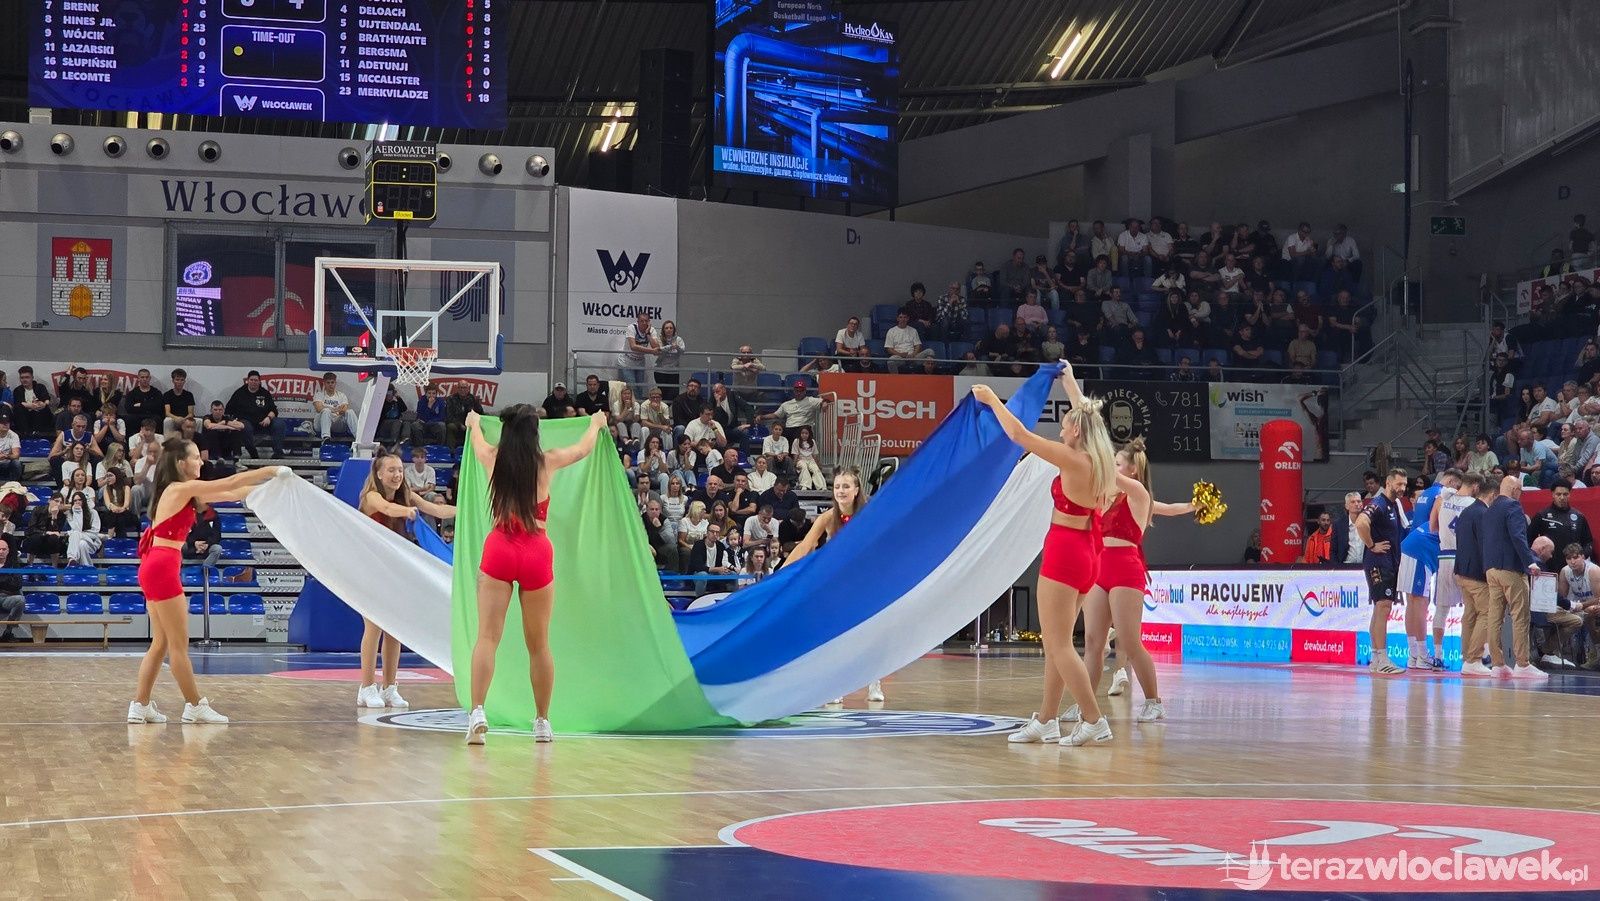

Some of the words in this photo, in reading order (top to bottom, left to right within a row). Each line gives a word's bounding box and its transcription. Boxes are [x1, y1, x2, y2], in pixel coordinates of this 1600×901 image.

[45, 1, 52, 9] 7
[63, 2, 99, 12] BRENK
[182, 9, 188, 17] 1
[199, 10, 206, 18] 6
[340, 5, 347, 13] 4
[358, 6, 406, 17] DELOACH
[484, 14, 490, 22] 8
[777, 1, 805, 10] European
[45, 15, 52, 23] 8
[63, 16, 95, 26] HINES
[99, 18, 116, 27] JR.
[193, 23, 206, 32] 23
[773, 11, 805, 21] Basketball
[340, 19, 347, 27] 5
[358, 20, 422, 31] UIJTENDAAL
[484, 27, 490, 35] 8
[44, 29, 52, 37] 9
[62, 28, 105, 40] WÓJCIK
[181, 36, 188, 45] 0
[199, 38, 206, 46] 0
[252, 31, 296, 44] TIME-OUT
[340, 32, 347, 40] 6
[358, 33, 427, 45] BRATHWAITE
[484, 41, 490, 49] 5
[44, 43, 55, 51] 11
[62, 43, 114, 55] ŁAZARSKI
[198, 51, 206, 60] 0
[340, 46, 347, 54] 7
[358, 47, 407, 58] BERGSMA
[467, 53, 473, 61] 1
[483, 54, 490, 62] 2
[44, 57, 56, 65] 16
[62, 57, 117, 69] SŁUPIŃSKI
[198, 65, 206, 73] 2
[340, 59, 350, 68] 11
[358, 60, 409, 71] ADETUNJI
[483, 67, 490, 76] 0
[43, 71, 57, 79] 20
[62, 71, 111, 82] LECOMTE
[198, 79, 205, 87] 5
[339, 73, 351, 82] 15
[357, 74, 420, 86] MCCALISTER
[467, 80, 473, 88] 1
[483, 80, 490, 89] 0
[339, 87, 352, 96] 23
[357, 87, 429, 100] MERKVILADZE
[466, 93, 472, 102] 1
[478, 93, 490, 102] 18
[261, 100, 313, 111] WŁOCŁAWEK
[374, 145, 435, 155] AEROWATCH
[721, 148, 769, 166] WEWNĘTRZNE
[769, 152, 809, 171] INSTALACJE
[582, 301, 662, 320] WŁOCŁAWEK
[587, 327, 609, 335] Miasto
[1170, 391, 1201, 407] 781
[1226, 388, 1265, 403] wish
[837, 399, 936, 420] BUSCH
[1171, 413, 1202, 429] 715
[1173, 435, 1202, 451] 511
[1274, 461, 1301, 470] ORLEN
[1153, 583, 1184, 604] drewbud
[1190, 583, 1285, 603] PRACUJEMY
[1319, 586, 1359, 608] drewbud
[1205, 605, 1219, 616] dla
[1221, 604, 1269, 621] najlepszych
[1141, 632, 1173, 645] drewbud.net.pl
[1183, 634, 1205, 646] TOMASZ
[1303, 640, 1344, 655] drewbud.net.pl
